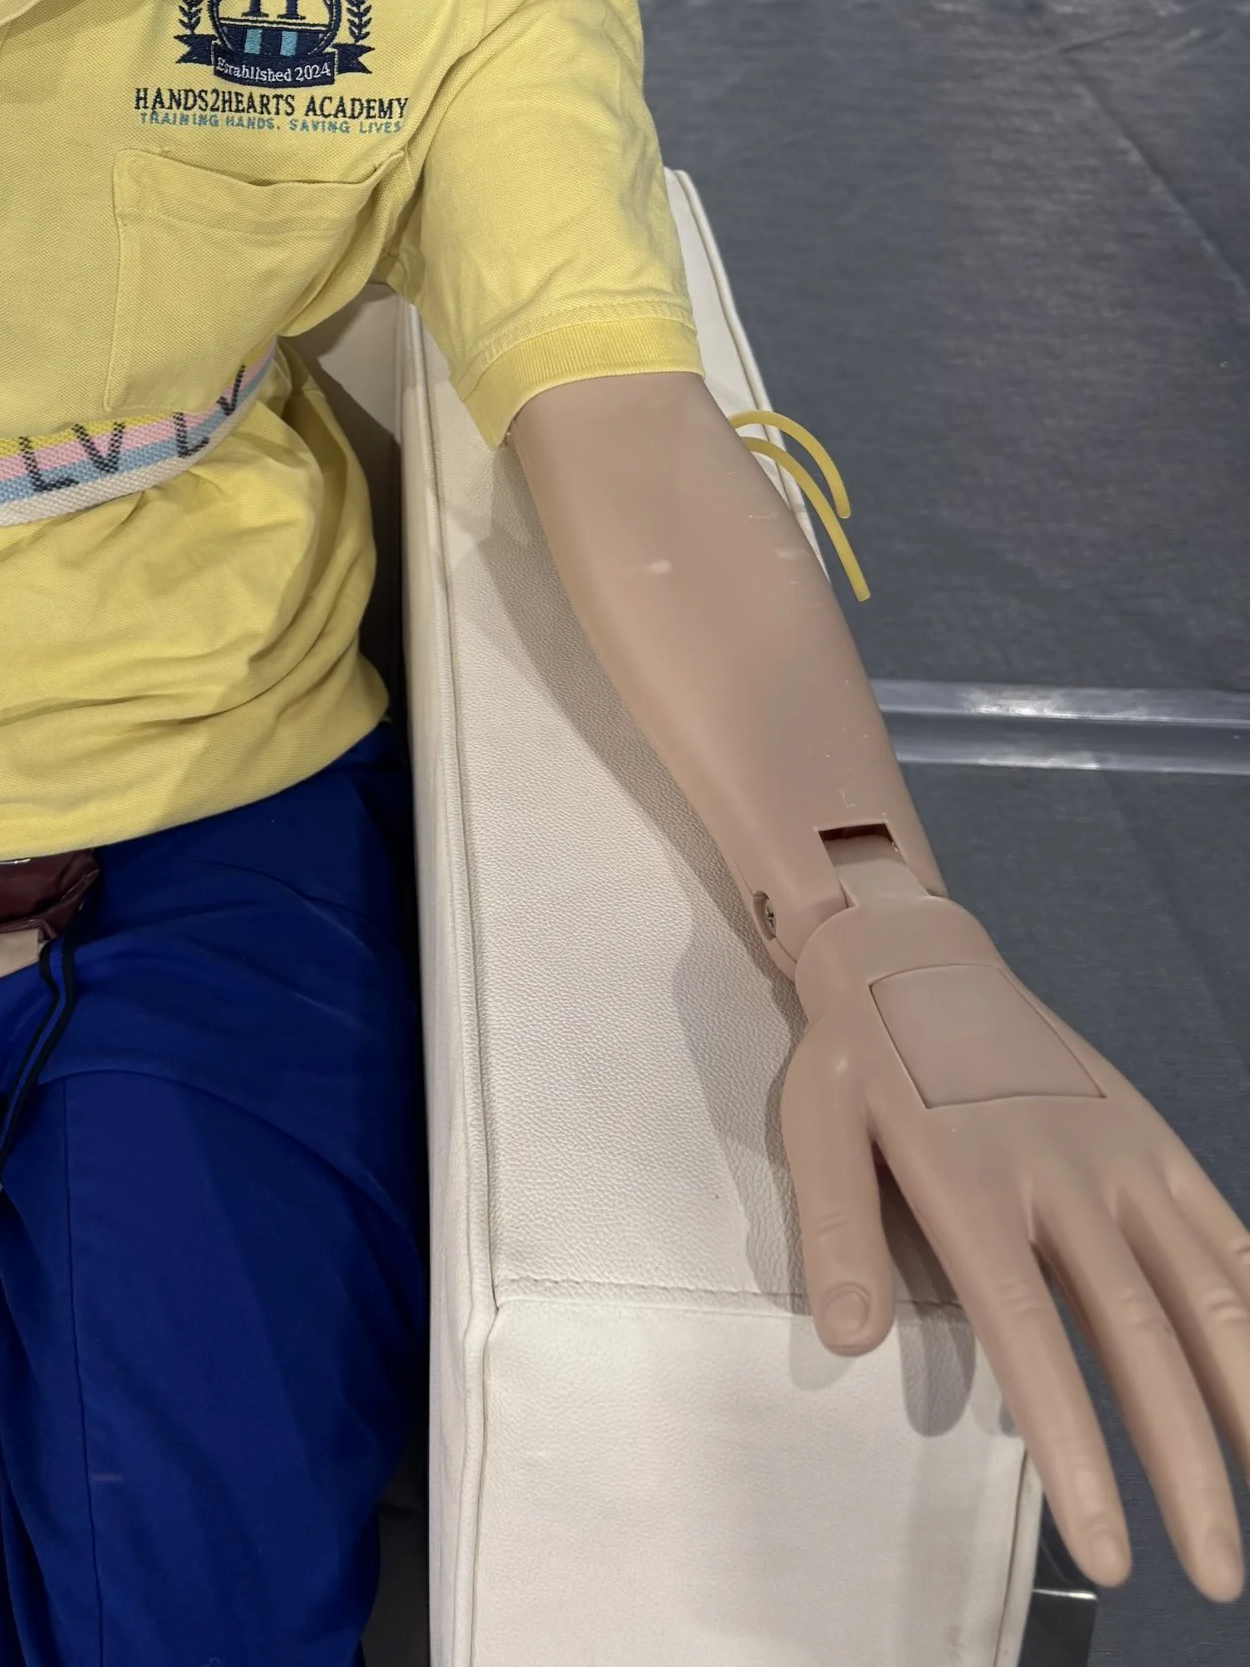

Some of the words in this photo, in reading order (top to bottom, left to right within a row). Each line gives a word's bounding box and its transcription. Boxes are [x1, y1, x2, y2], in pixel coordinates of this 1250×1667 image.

[216, 56, 292, 82] Established
[294, 62, 332, 82] 2024
[134, 87, 296, 117] HANDS2HEARTS
[304, 95, 409, 121] ACADEMY
[140, 111, 220, 127] TRAINING
[289, 118, 350, 134] SAVING
[359, 120, 402, 134] LIVES
[19, 420, 125, 492] LV
